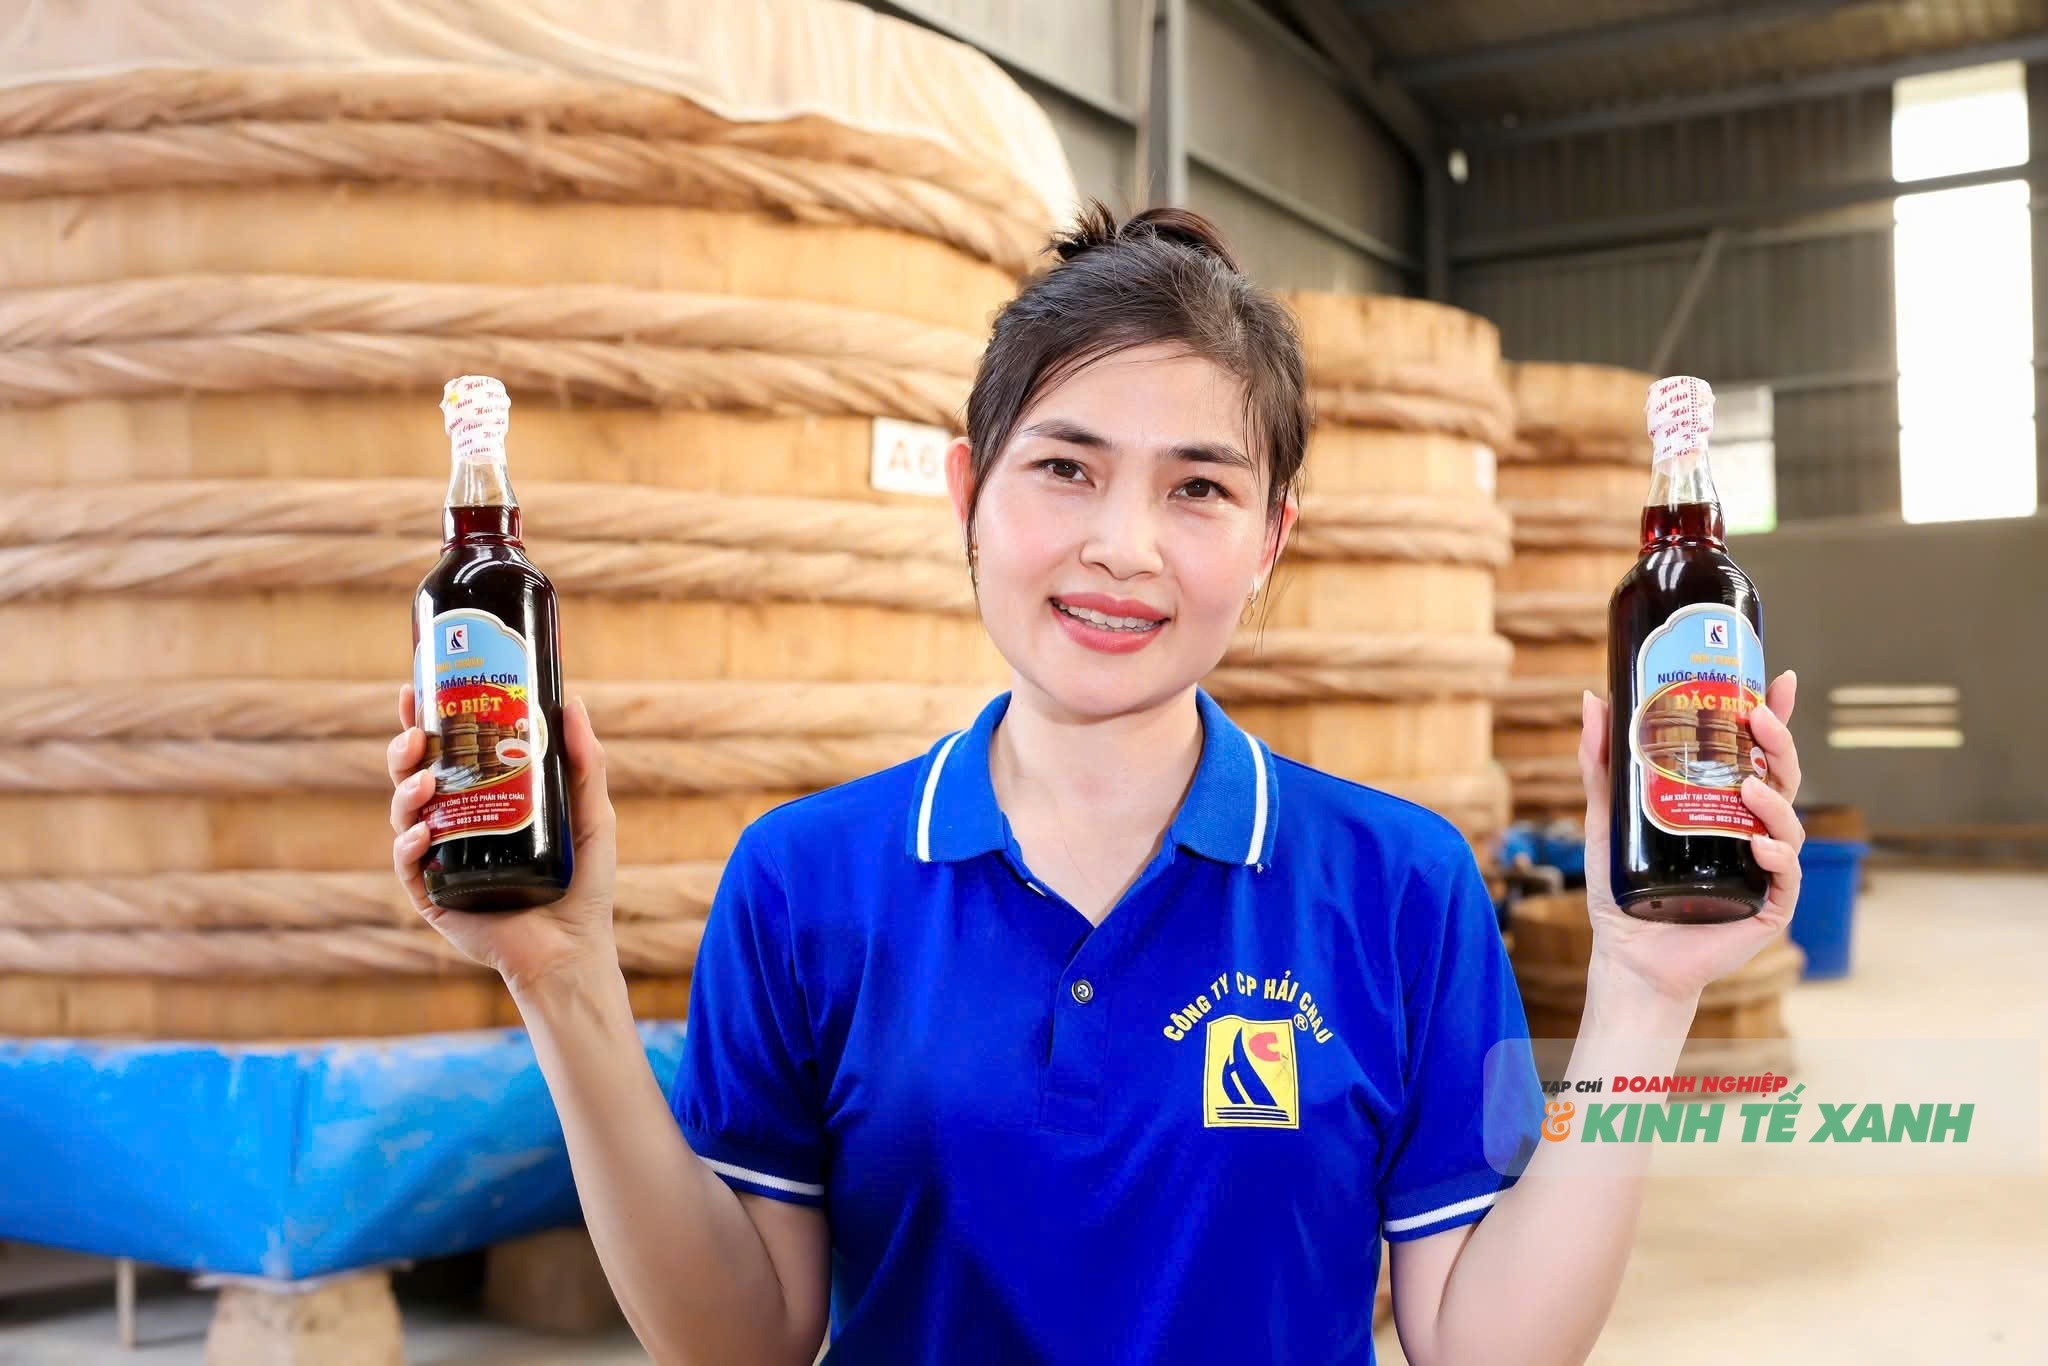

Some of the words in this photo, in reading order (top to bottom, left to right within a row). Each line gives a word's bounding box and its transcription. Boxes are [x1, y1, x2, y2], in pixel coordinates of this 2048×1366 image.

[460, 692, 503, 716] BIỆT
[1163, 994, 1212, 1042] CÔNG
[1210, 972, 1230, 1001] TY
[1235, 970, 1258, 997] CP
[1263, 970, 1299, 1003] HẢI
[1298, 991, 1335, 1045] CHÂU
